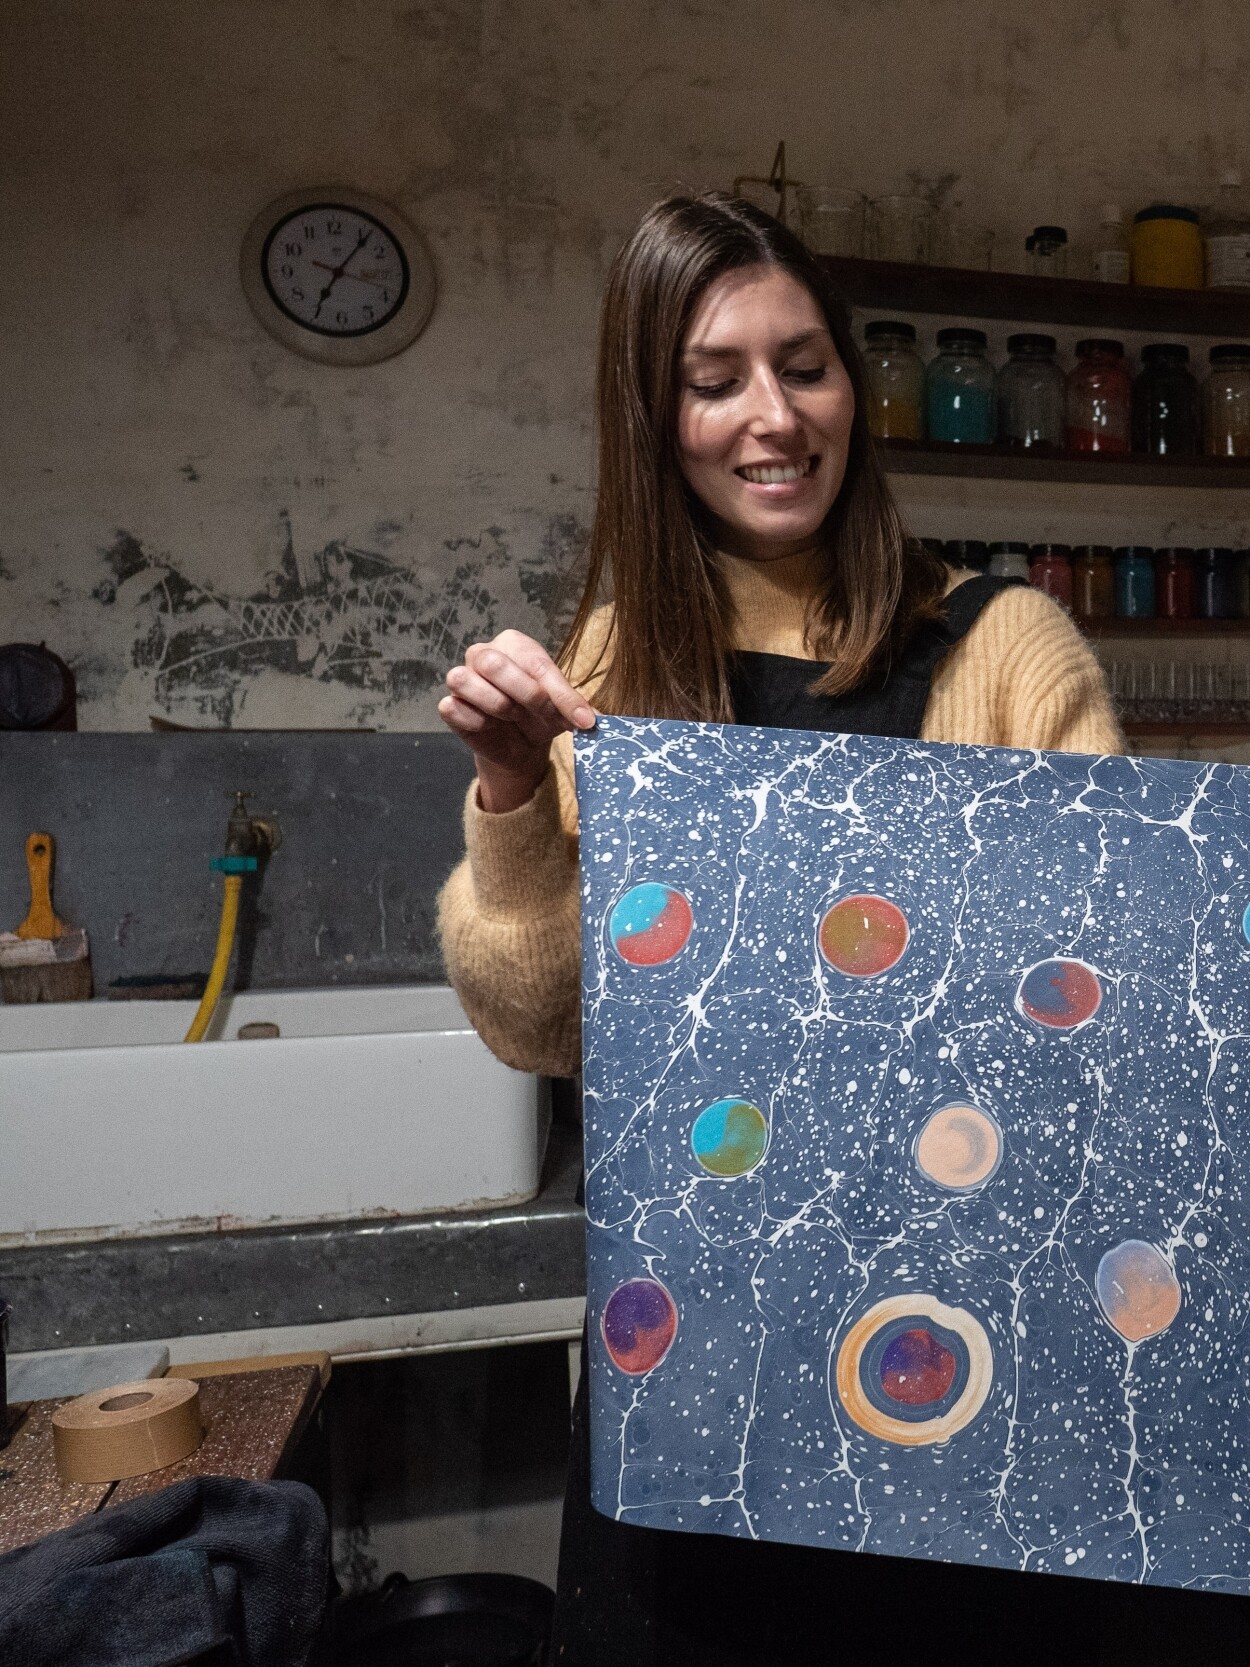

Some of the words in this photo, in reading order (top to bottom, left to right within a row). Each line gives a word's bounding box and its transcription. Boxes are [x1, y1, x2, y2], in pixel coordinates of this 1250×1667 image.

[304, 226, 315, 239] 11
[326, 221, 342, 235] 12
[285, 243, 302, 256] 10
[374, 246, 386, 259] 2
[281, 265, 293, 279] 9
[336, 311, 348, 325] 6
